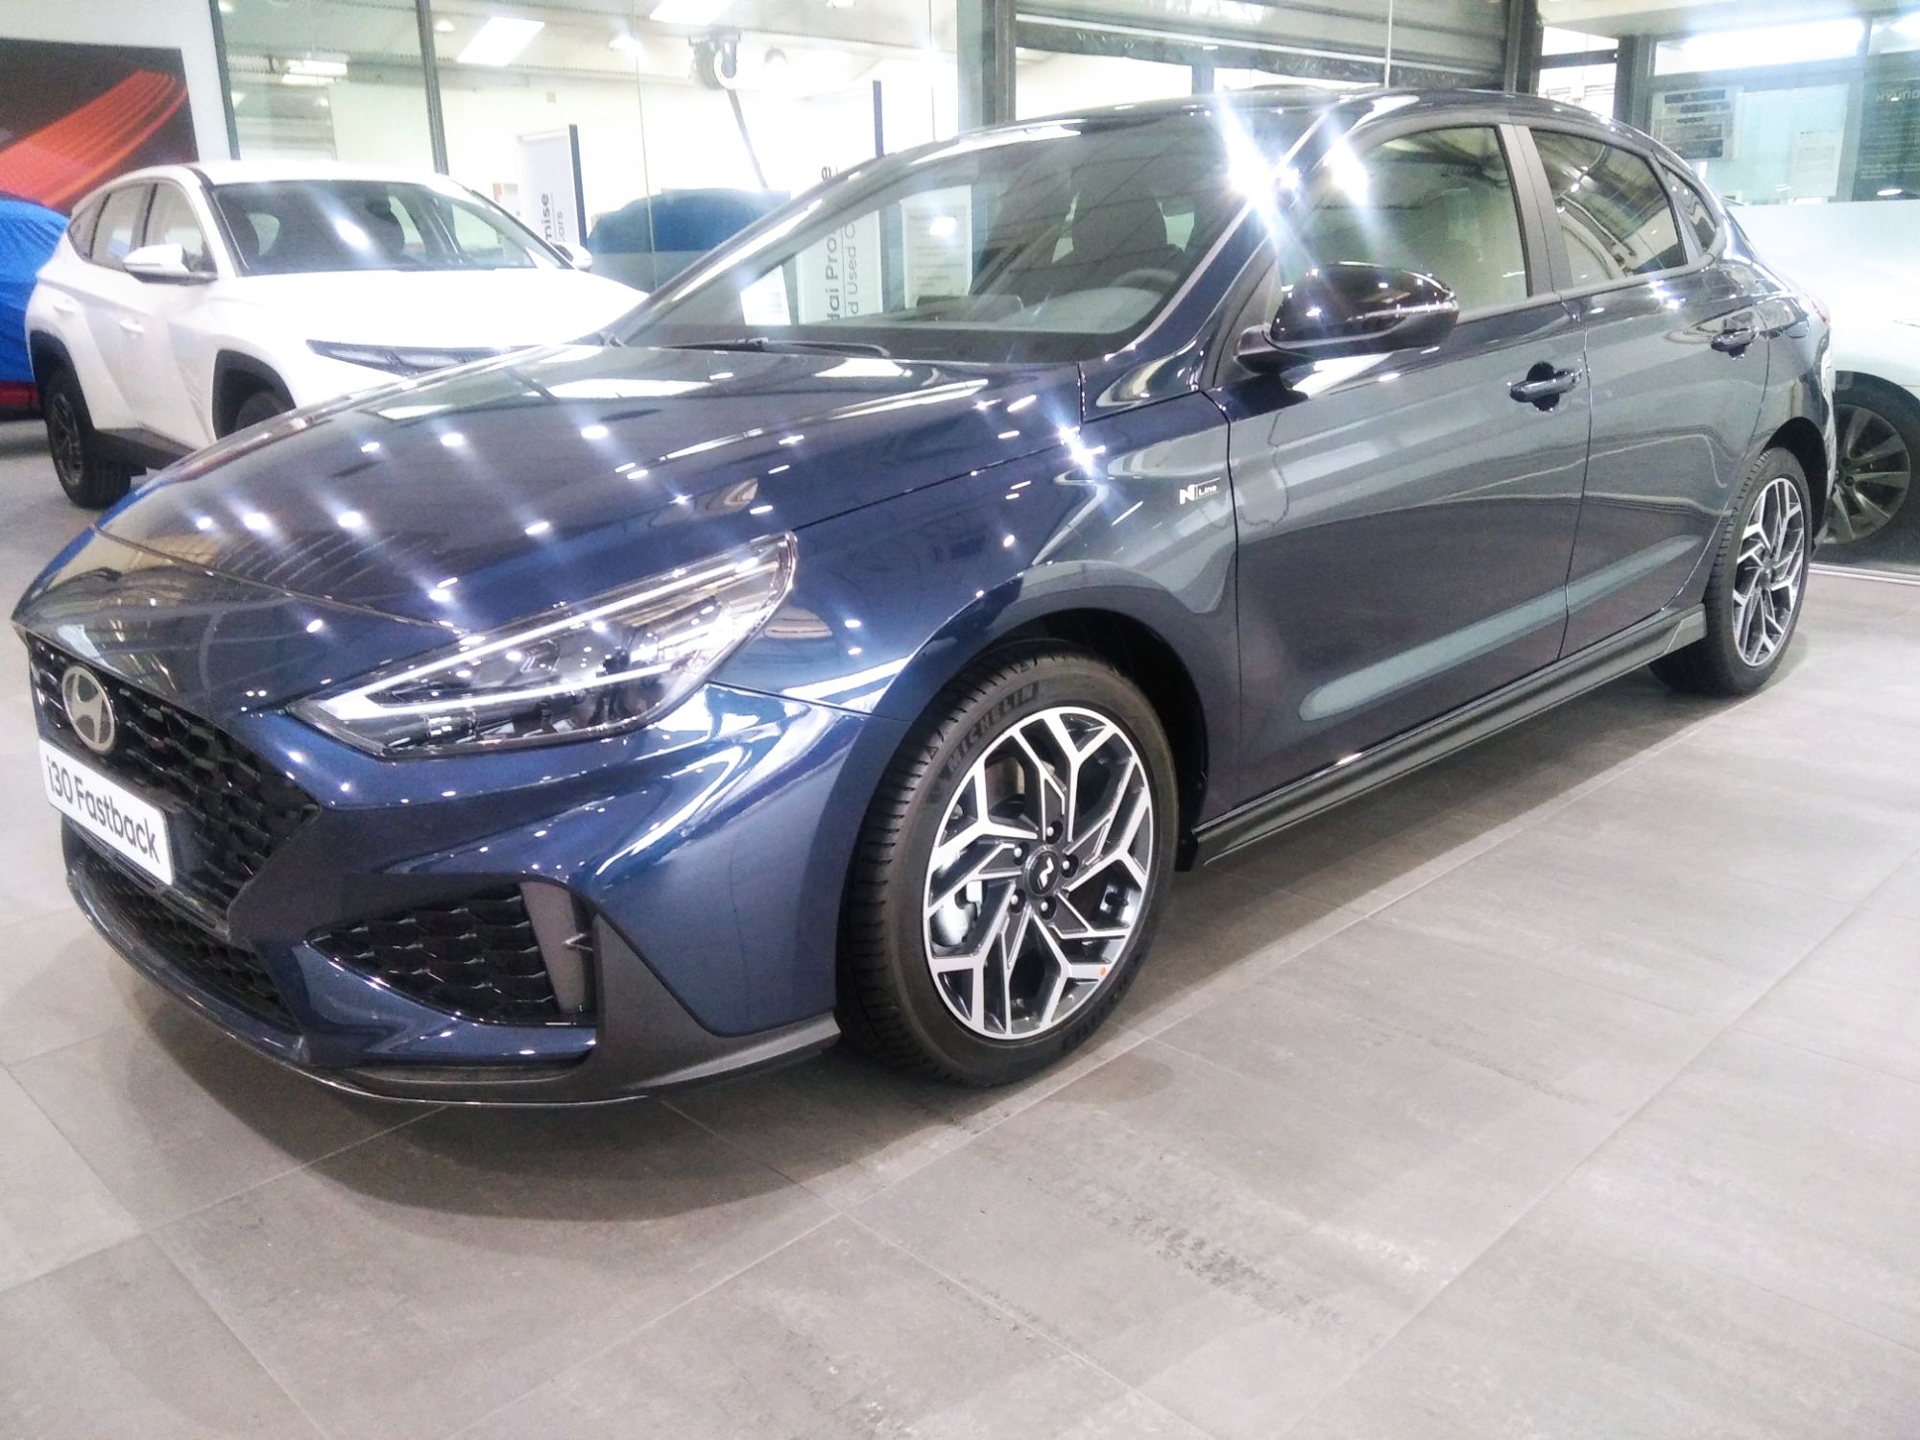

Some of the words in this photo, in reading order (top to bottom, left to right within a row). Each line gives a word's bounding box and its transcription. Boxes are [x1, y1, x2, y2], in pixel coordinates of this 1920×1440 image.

[846, 246, 858, 295] Used
[46, 755, 74, 804] i30
[74, 775, 161, 865] Fastback
